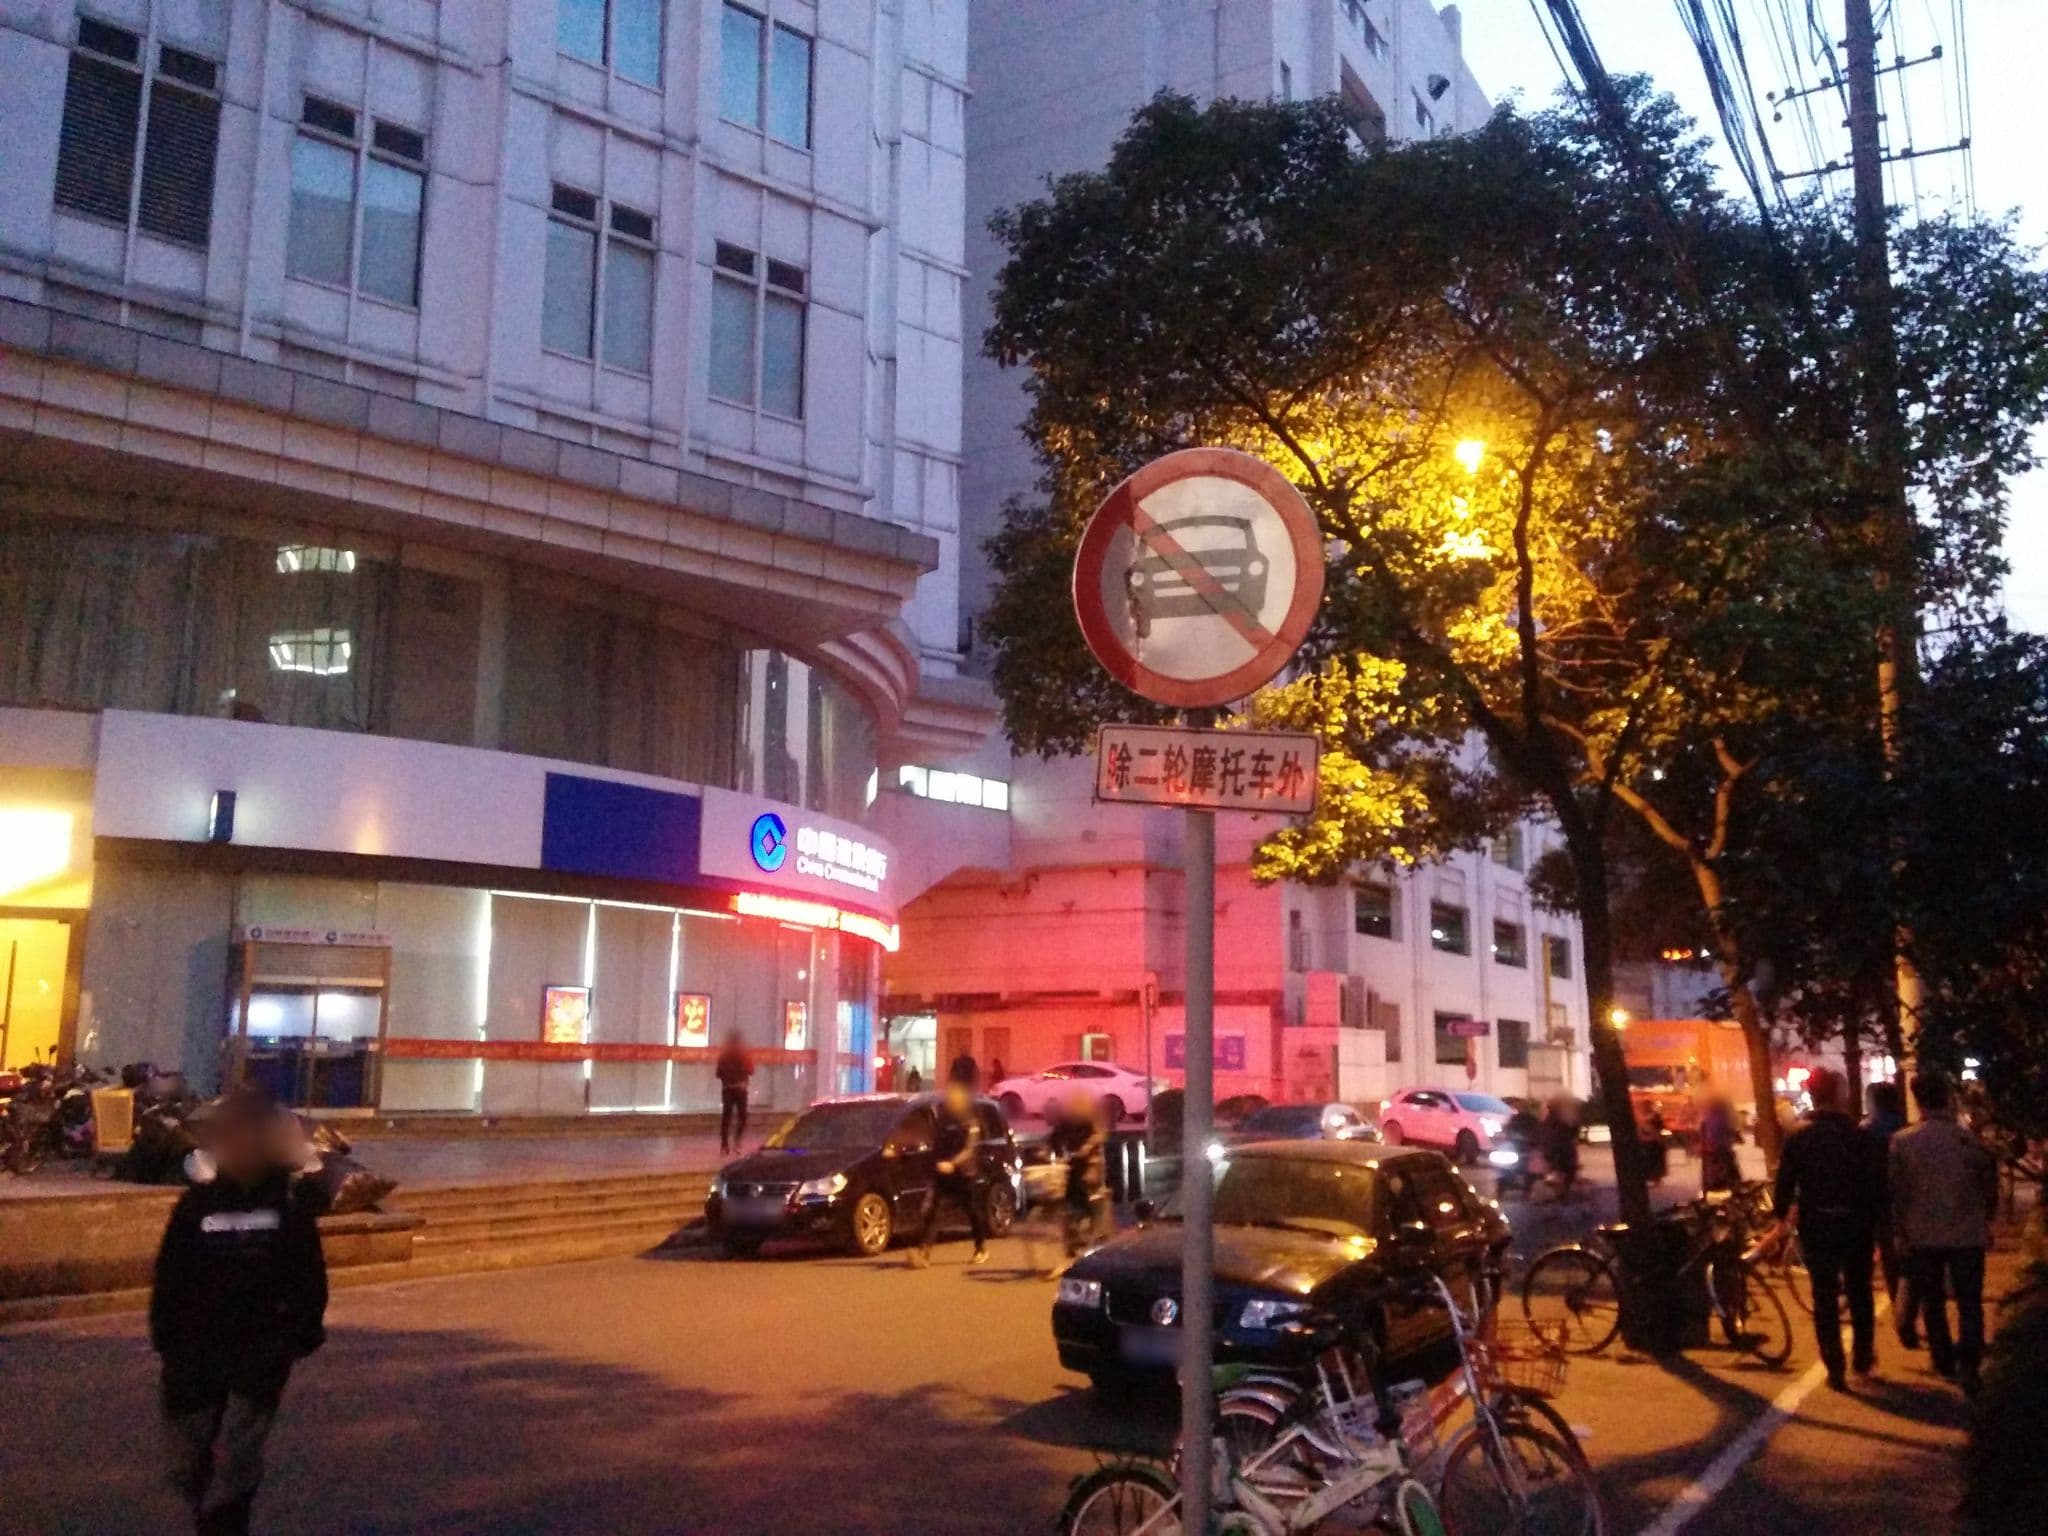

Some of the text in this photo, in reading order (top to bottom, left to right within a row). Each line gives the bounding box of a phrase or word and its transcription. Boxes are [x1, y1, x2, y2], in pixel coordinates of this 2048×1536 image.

[1107, 741, 1304, 799] 除二轮摩托车外
